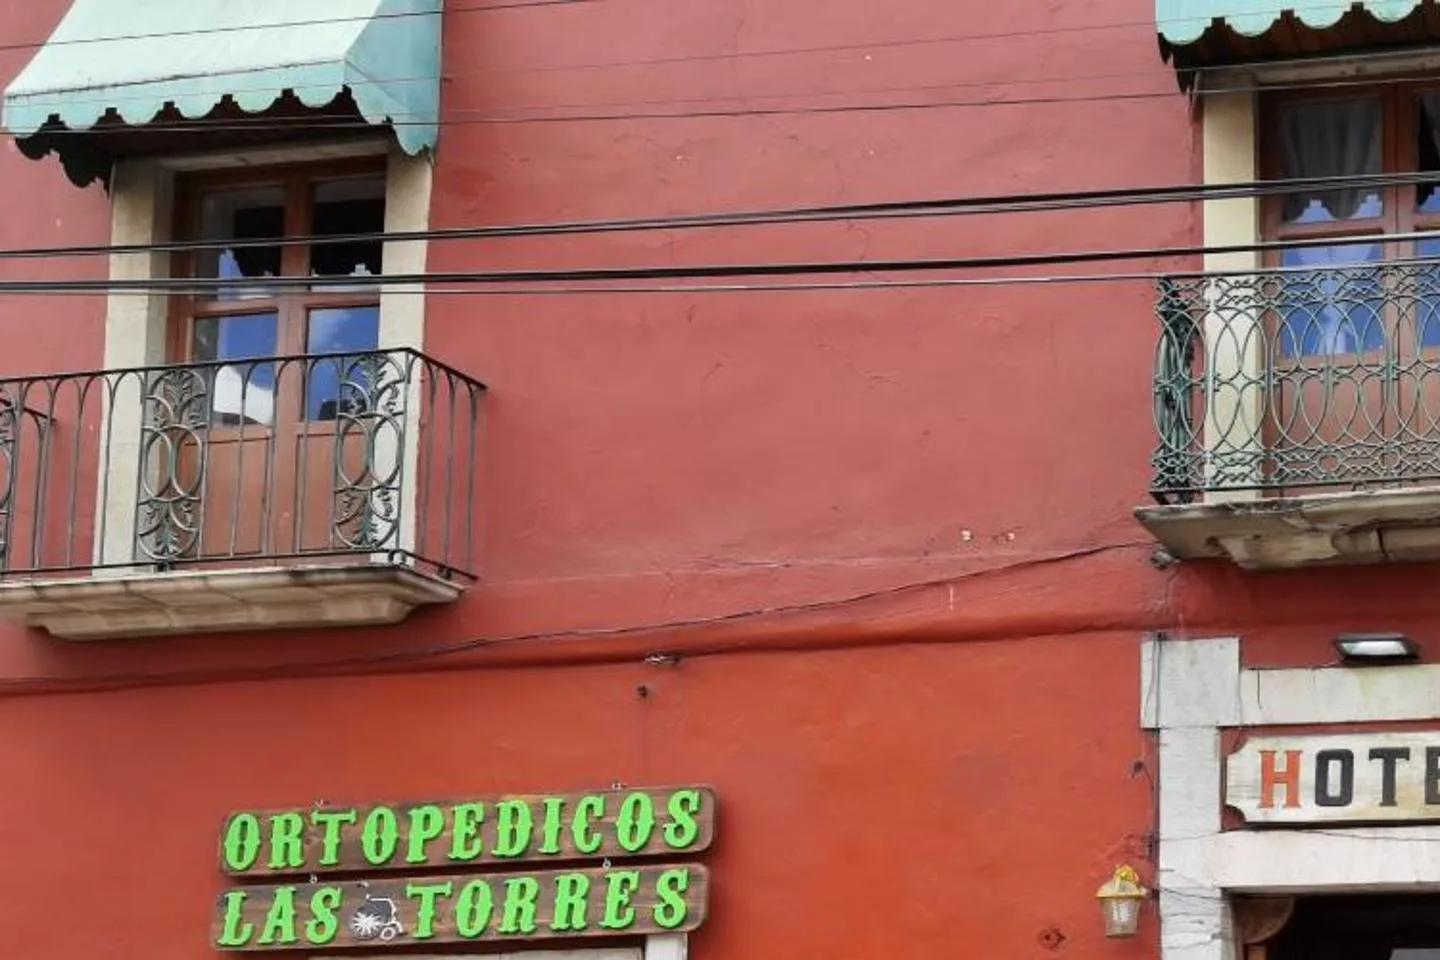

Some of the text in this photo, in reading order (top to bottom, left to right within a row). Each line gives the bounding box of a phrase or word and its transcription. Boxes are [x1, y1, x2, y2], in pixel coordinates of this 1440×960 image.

[223, 789, 702, 871] ORTOPEDICOS
[217, 867, 690, 946] LAS TORRES
